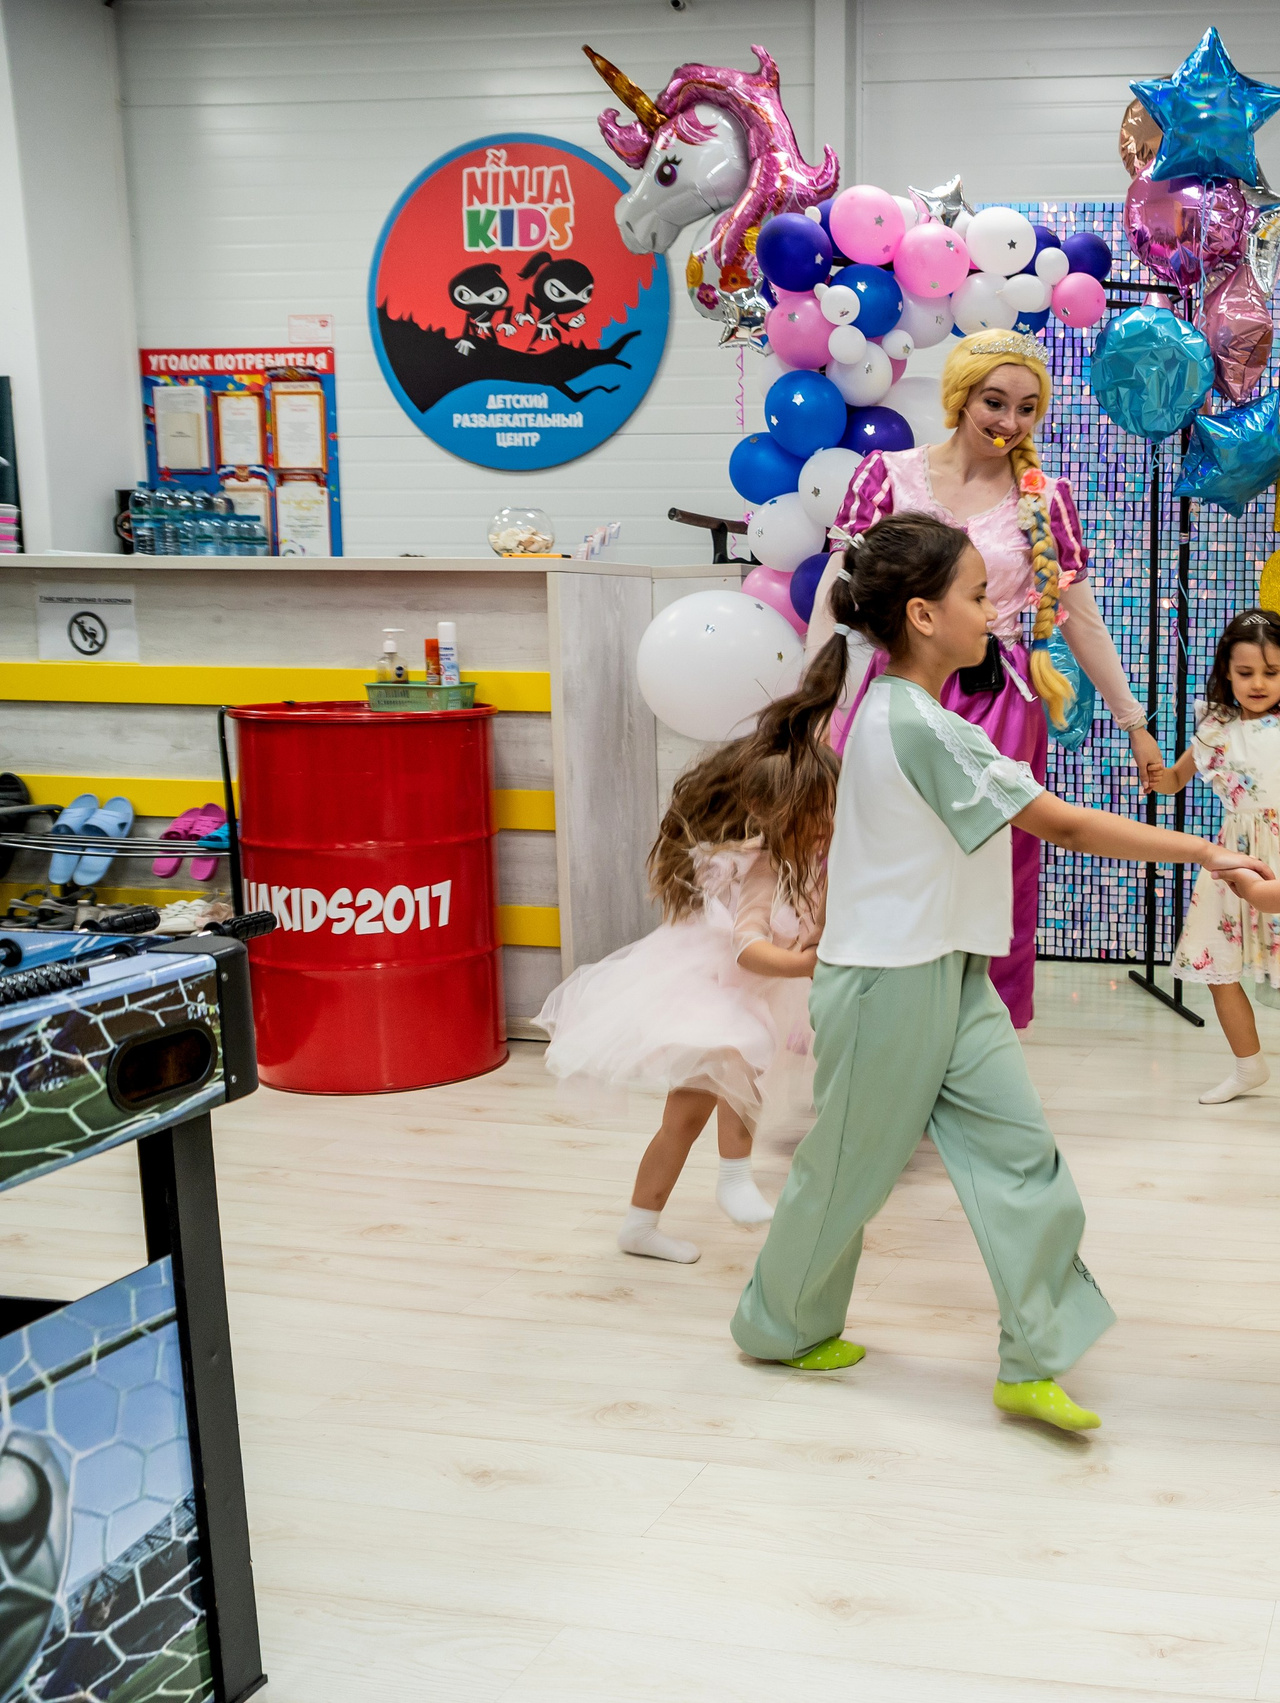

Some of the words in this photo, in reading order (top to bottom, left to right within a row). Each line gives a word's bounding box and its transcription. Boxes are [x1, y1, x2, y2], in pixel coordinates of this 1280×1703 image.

[463, 165, 574, 207] NINJA
[463, 204, 574, 253] KIDS
[148, 353, 211, 371] УГОЛОК
[213, 352, 328, 371] ПОТРЕБИТЕЛЯ
[486, 392, 548, 409] ДЕТСКИЙ
[453, 411, 584, 428] РАЗВЛЕКАТЕЛЬНЫЙ
[496, 432, 540, 448] ЦЕНТР
